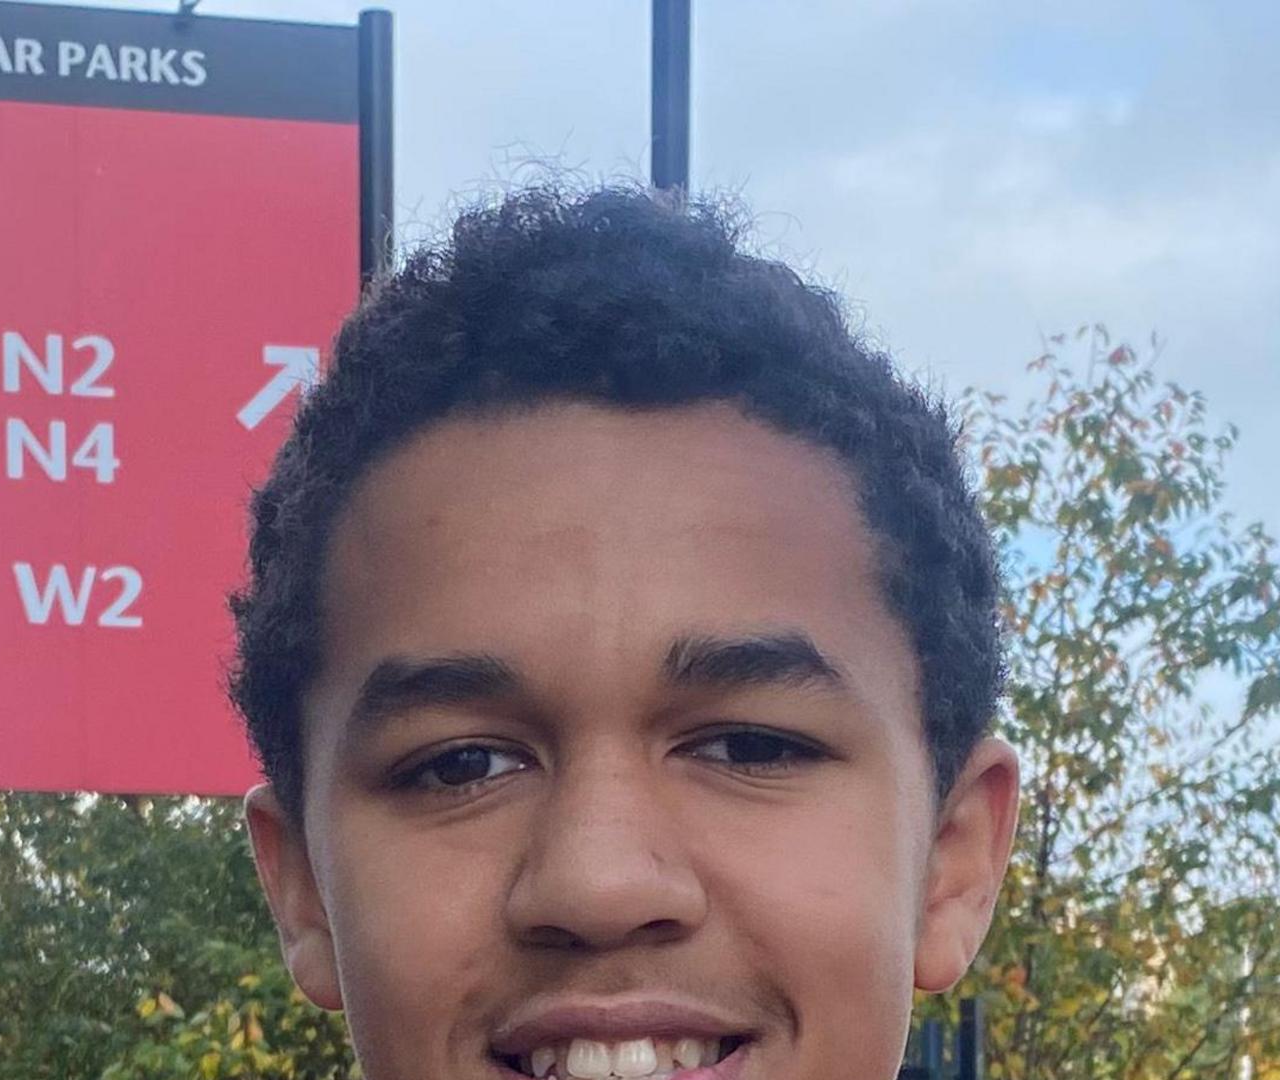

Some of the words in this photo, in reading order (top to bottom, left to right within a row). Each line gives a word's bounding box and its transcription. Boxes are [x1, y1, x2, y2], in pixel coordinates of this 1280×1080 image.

[58, 41, 207, 87] PARKS
[2, 331, 116, 398] N2
[6, 417, 121, 483] N4
[13, 562, 143, 627] W2
